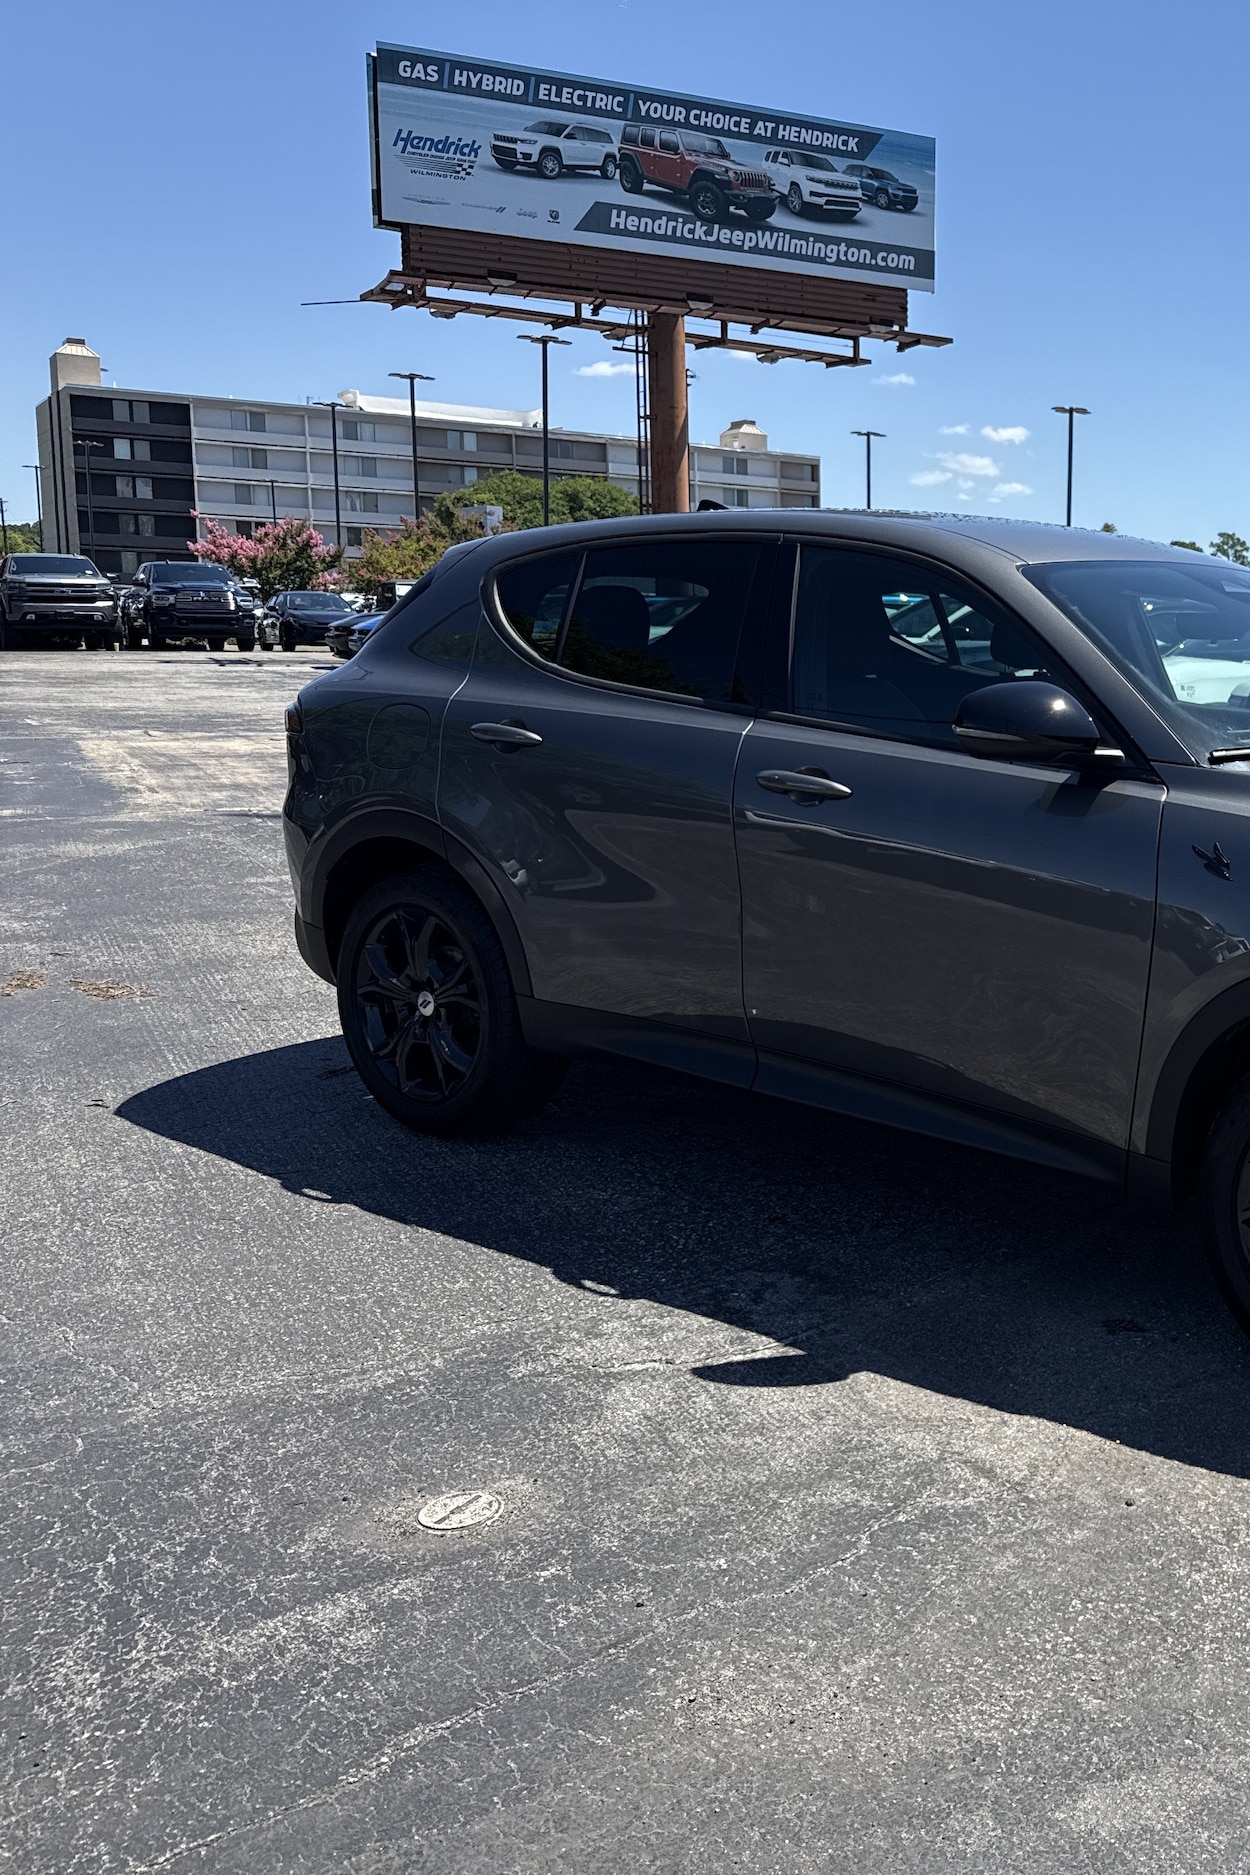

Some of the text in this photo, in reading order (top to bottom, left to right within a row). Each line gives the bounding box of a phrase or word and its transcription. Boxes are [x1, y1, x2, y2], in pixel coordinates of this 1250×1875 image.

[398, 60, 860, 153] GAS HYBRID ELECTRIC YOUR CHOICE AT HENDRICK
[392, 128, 482, 159] Hendrick
[410, 168, 467, 181] WILMINGTON
[609, 208, 916, 271] HendrickJeepWilmington.com
